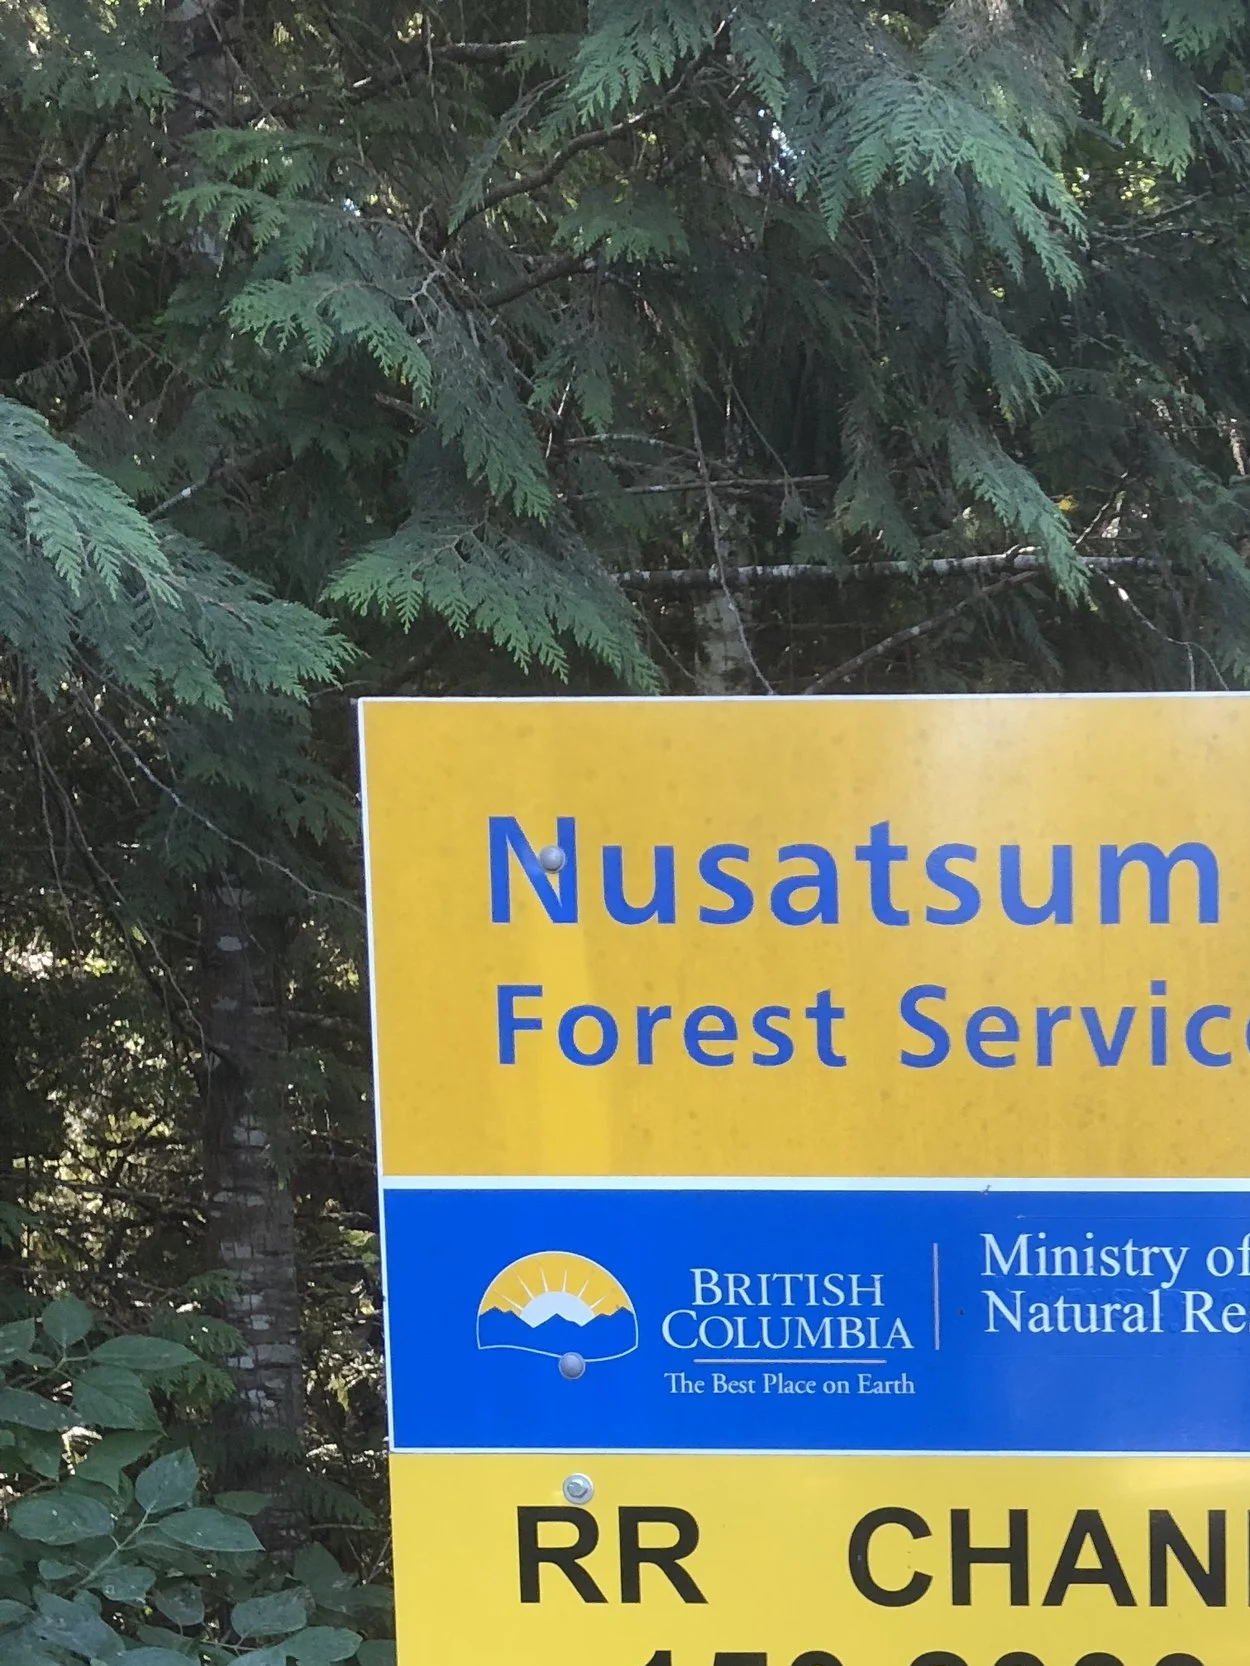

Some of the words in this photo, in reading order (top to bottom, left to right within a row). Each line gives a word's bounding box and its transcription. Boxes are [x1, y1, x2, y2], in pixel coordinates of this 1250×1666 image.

[489, 817, 1218, 925] Nusatsum
[498, 986, 844, 1066] Forest
[981, 1233, 1189, 1289] Ministry
[691, 1269, 883, 1306] BRITISH
[983, 1289, 1164, 1333] Natural
[663, 1310, 913, 1348] COLUMBIA
[664, 1372, 705, 1394] The
[711, 1373, 755, 1394] Best
[763, 1373, 816, 1394] Place
[823, 1381, 850, 1394] on
[857, 1373, 916, 1394] Earth
[518, 1506, 707, 1603] RR
